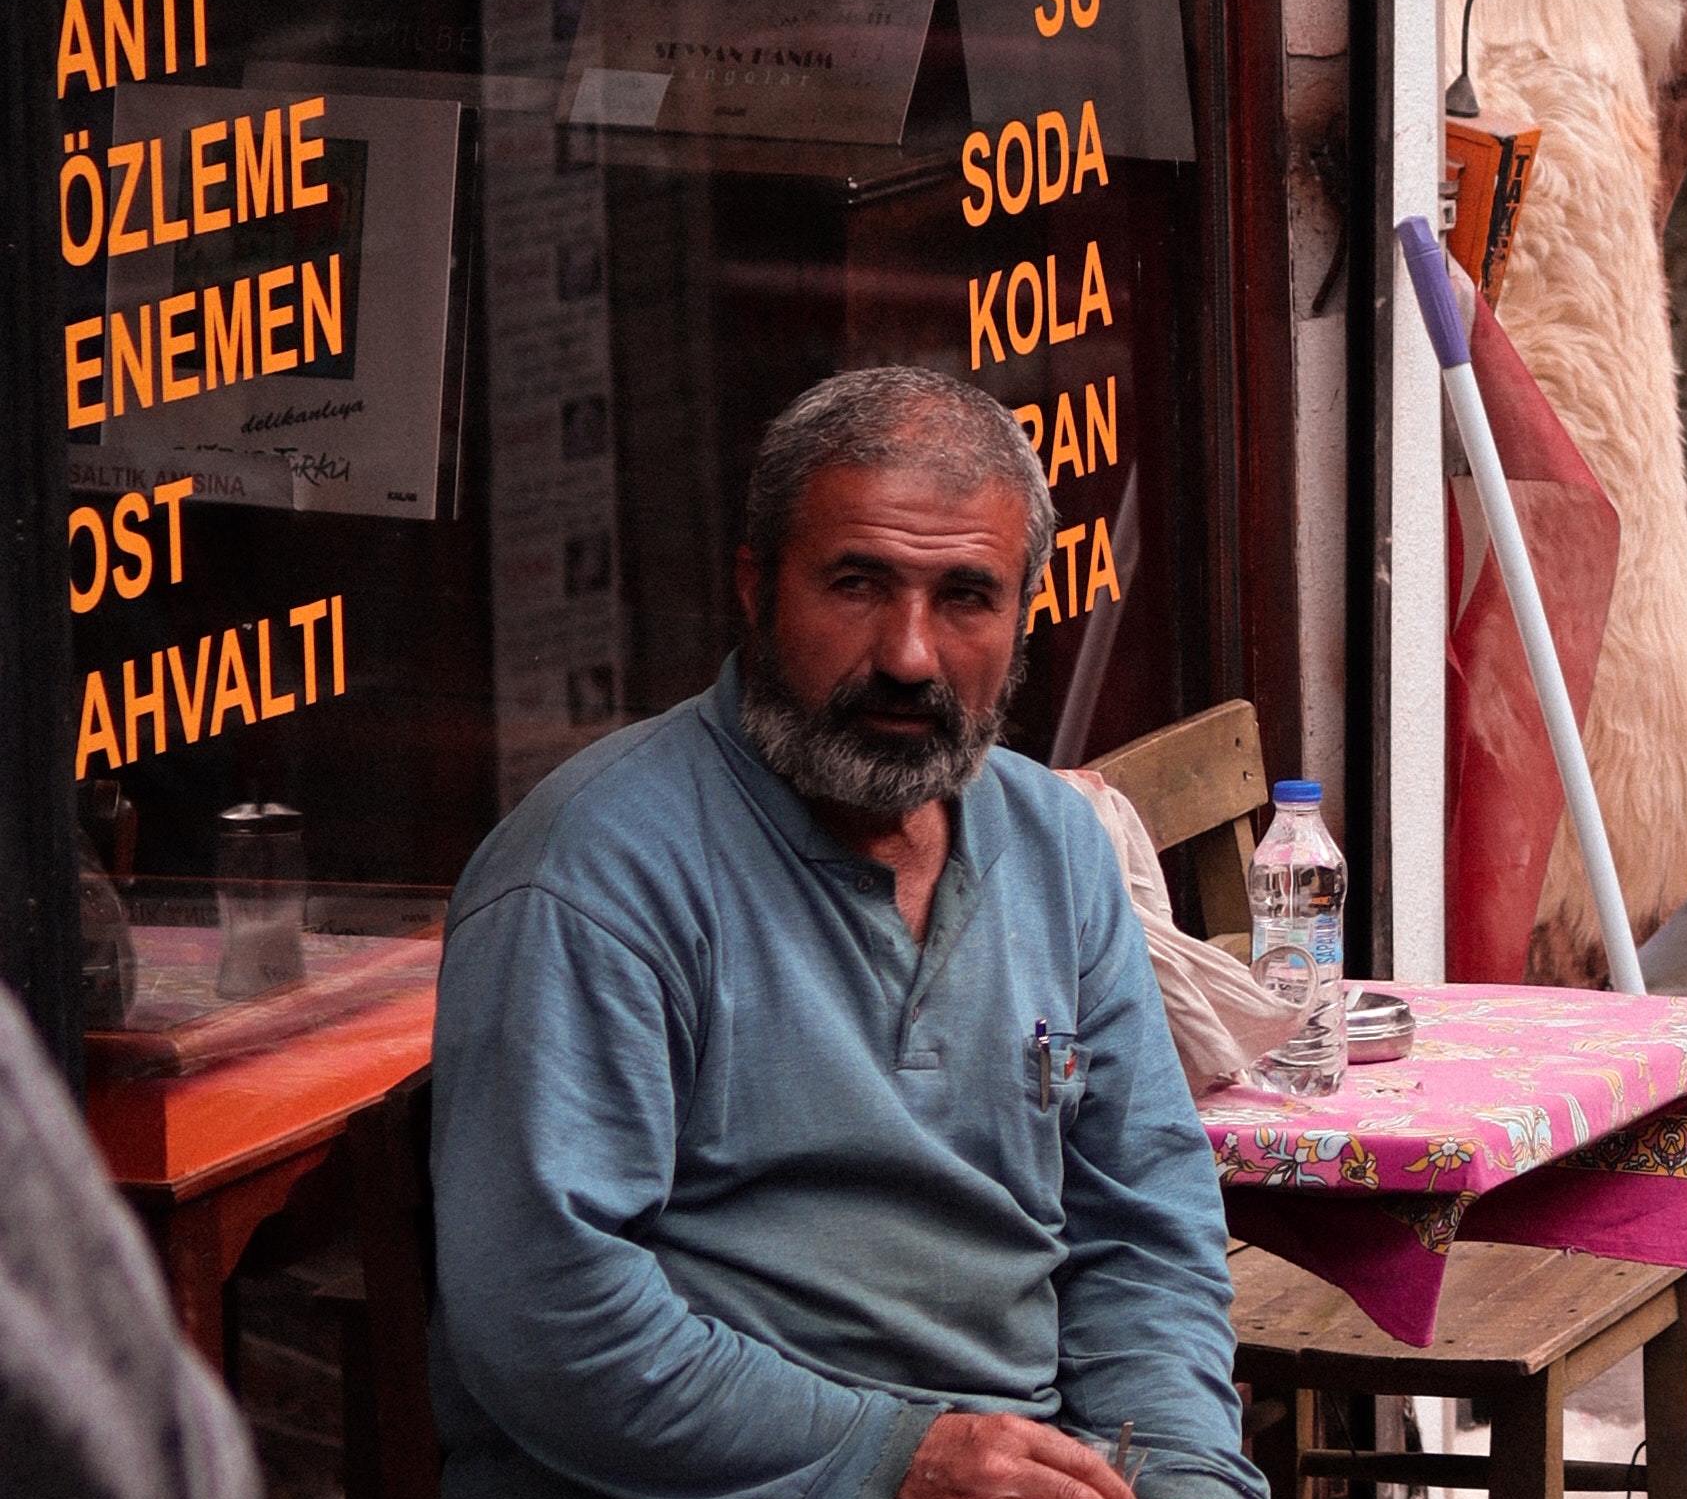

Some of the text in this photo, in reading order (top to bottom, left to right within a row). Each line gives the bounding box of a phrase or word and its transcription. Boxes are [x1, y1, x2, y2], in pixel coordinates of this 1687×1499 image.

[59, 96, 329, 267] ÖZLEME
[961, 99, 1109, 227] SODA
[64, 253, 342, 430] ENEMEN
[968, 240, 1113, 370] KOLA
[154, 466, 246, 498] ANSINA
[75, 594, 346, 781] AHVALTI
